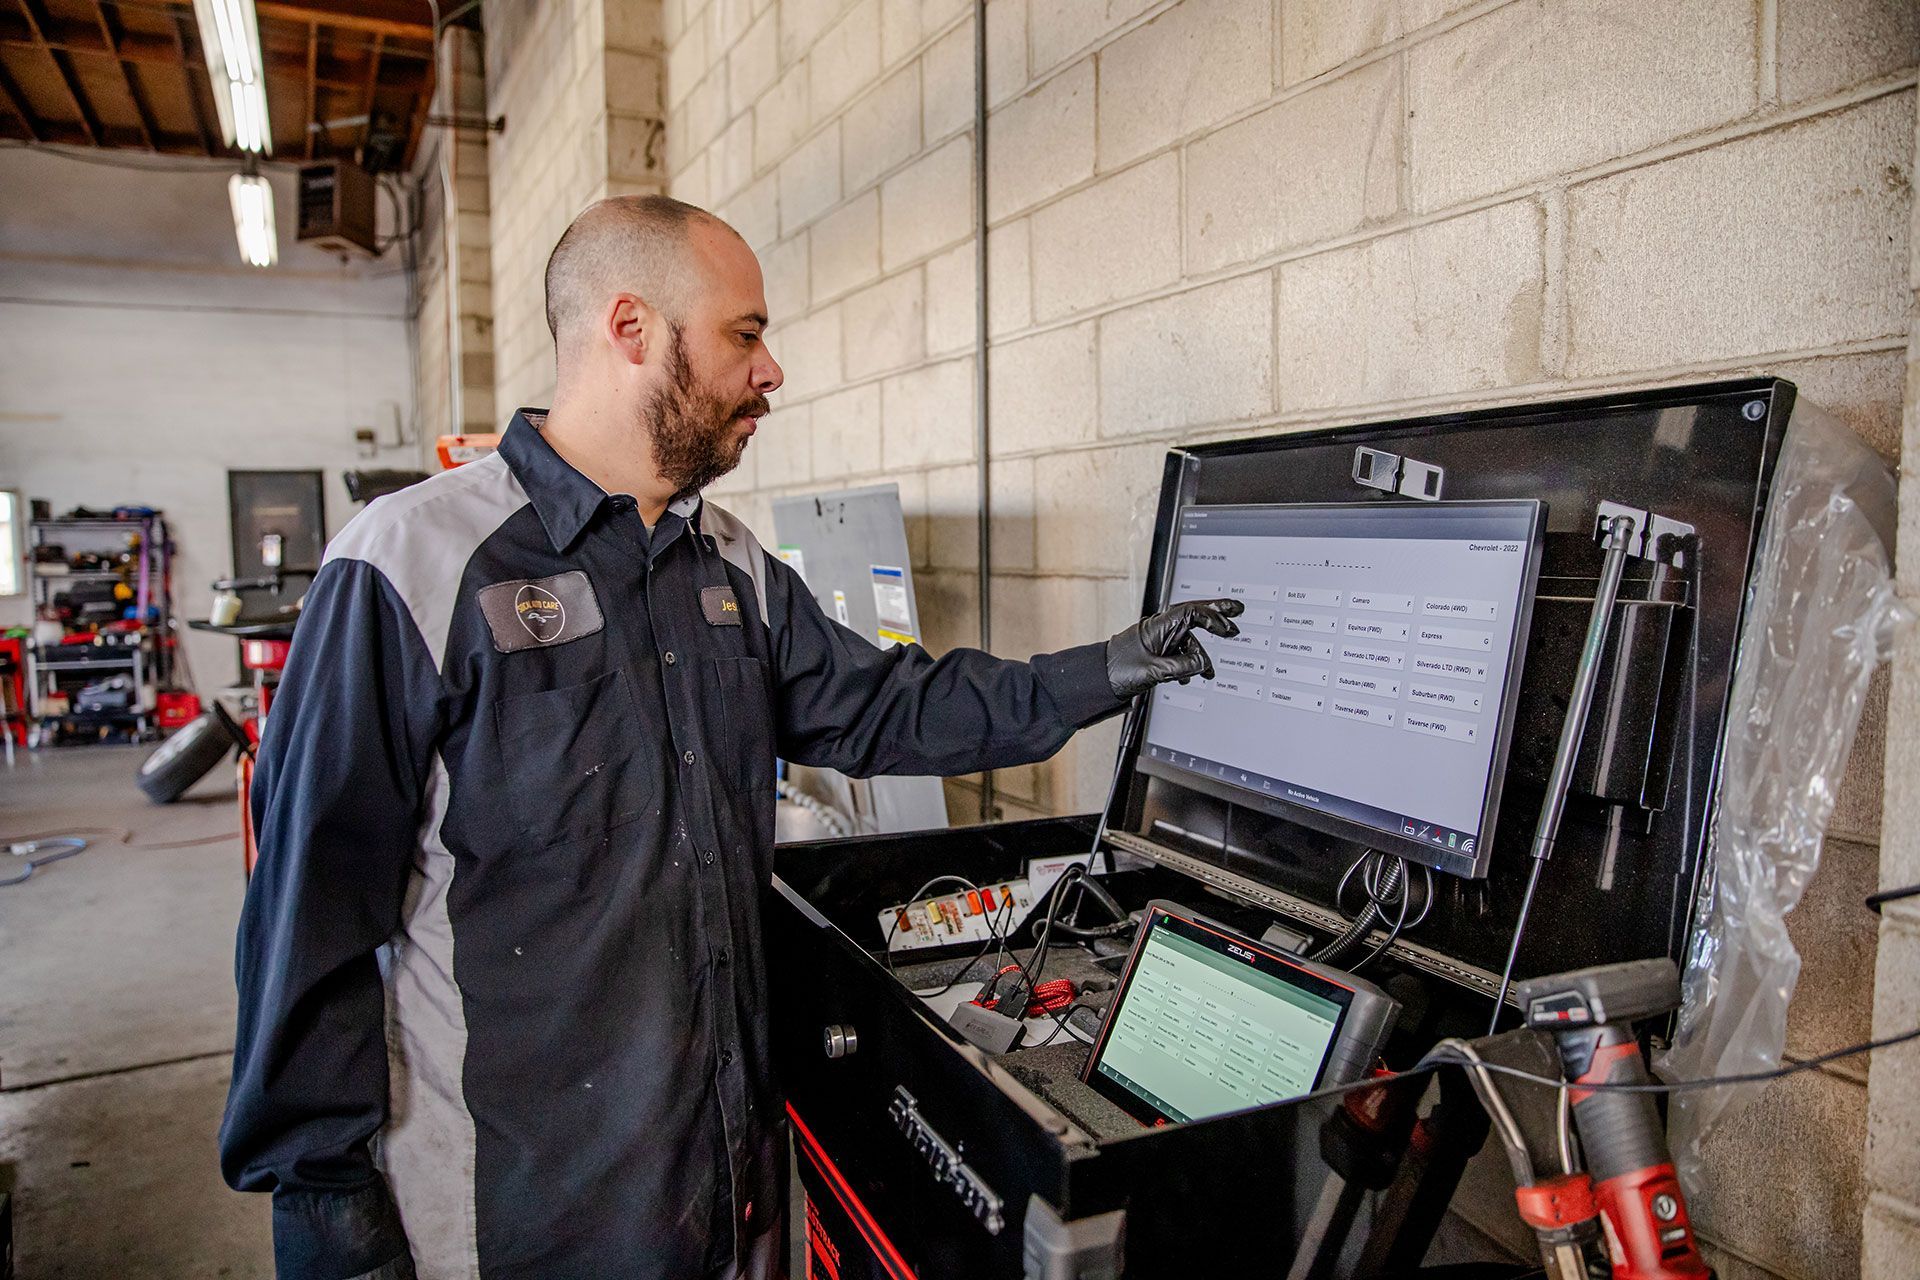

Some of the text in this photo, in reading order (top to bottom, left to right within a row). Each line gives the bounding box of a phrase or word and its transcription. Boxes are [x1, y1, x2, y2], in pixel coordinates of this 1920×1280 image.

[1468, 543, 1499, 553] Chevrolet
[1503, 544, 1519, 553] 2022
[542, 600, 560, 611] CARE
[1351, 596, 1371, 605] Camaro
[1406, 600, 1412, 608] F
[1425, 602, 1468, 613] Colorado (4WD)
[1283, 616, 1300, 625] Equinox
[1347, 623, 1382, 635] Equinox (FWD)
[1421, 631, 1443, 640] Express
[1279, 642, 1298, 651] Silverado
[1343, 650, 1365, 661] Silverado
[1364, 653, 1375, 661] LTD
[1275, 667, 1287, 675] Spark
[1416, 660, 1472, 675] Silverado LTD (RWD)
[1477, 668, 1485, 676] W
[1338, 677, 1361, 686] Suburban
[1271, 691, 1292, 701] Trailblazer
[1411, 688, 1456, 703] Suburban (RWD)
[1334, 703, 1370, 717] Traverse (AWD)
[1407, 717, 1447, 733] Traverse (FWD)
[1468, 729, 1474, 737] R
[1293, 790, 1306, 799] Active
[1305, 794, 1320, 803] Vehicle
